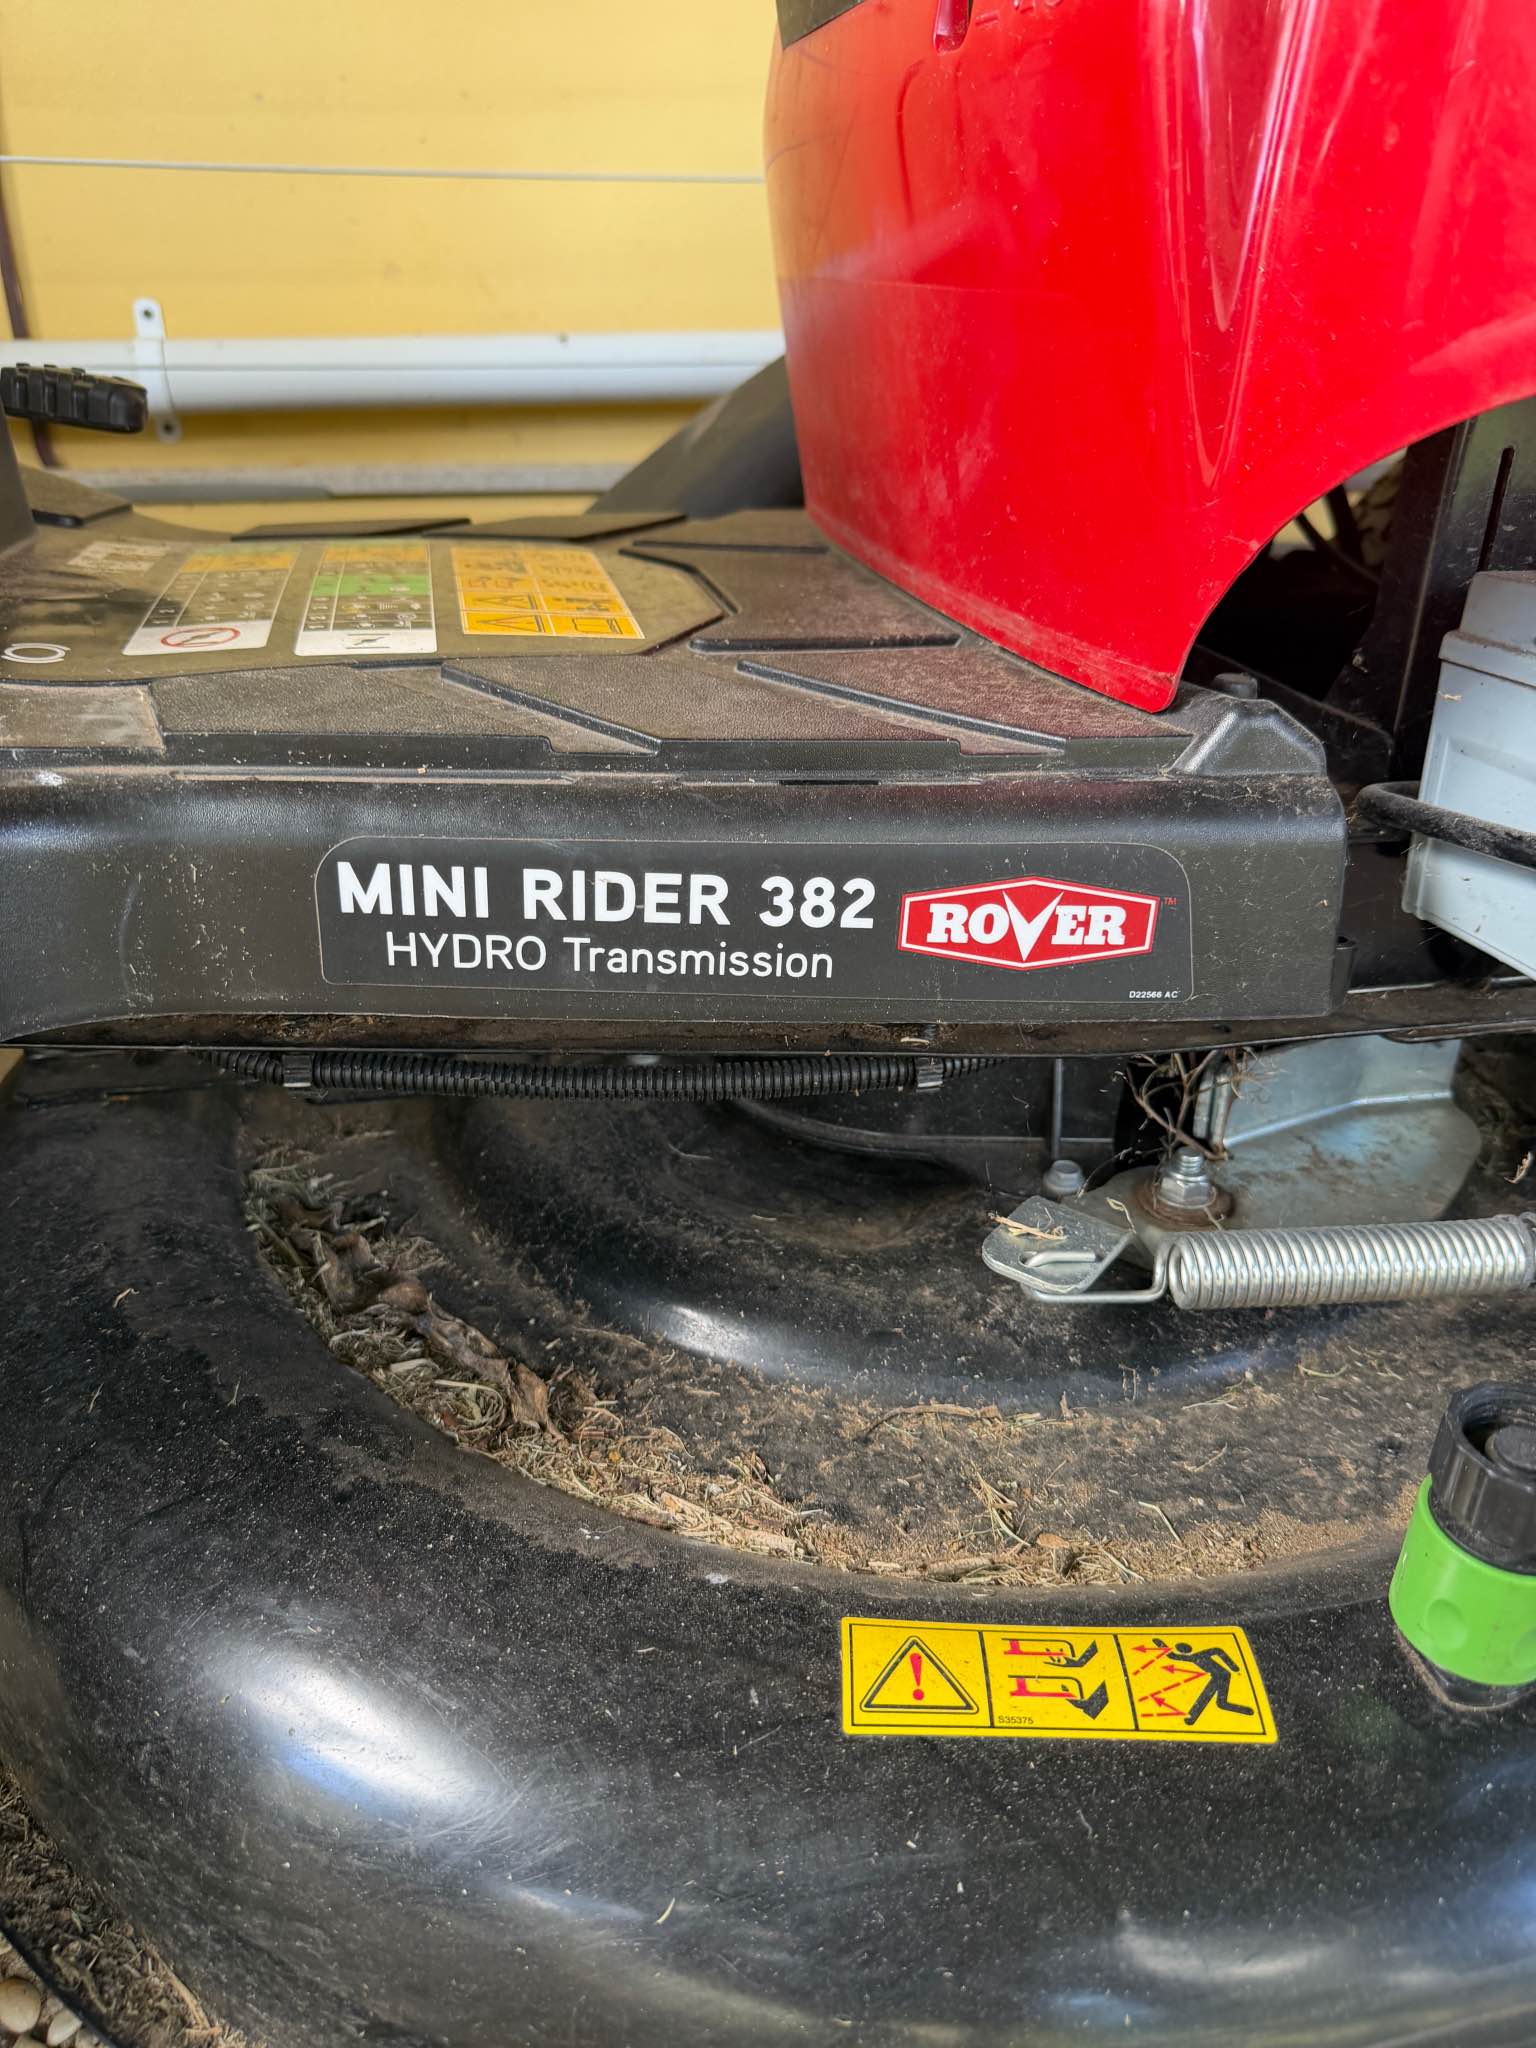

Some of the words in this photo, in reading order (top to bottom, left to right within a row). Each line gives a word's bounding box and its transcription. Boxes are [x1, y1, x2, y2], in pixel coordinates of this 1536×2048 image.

[336, 861, 489, 918] MINI
[522, 868, 731, 926] RIDER
[758, 876, 876, 929] 382
[385, 930, 547, 970] HYDRO
[562, 937, 833, 978] Transmission
[925, 890, 1127, 962] ROVER
[1129, 990, 1163, 999] D22566
